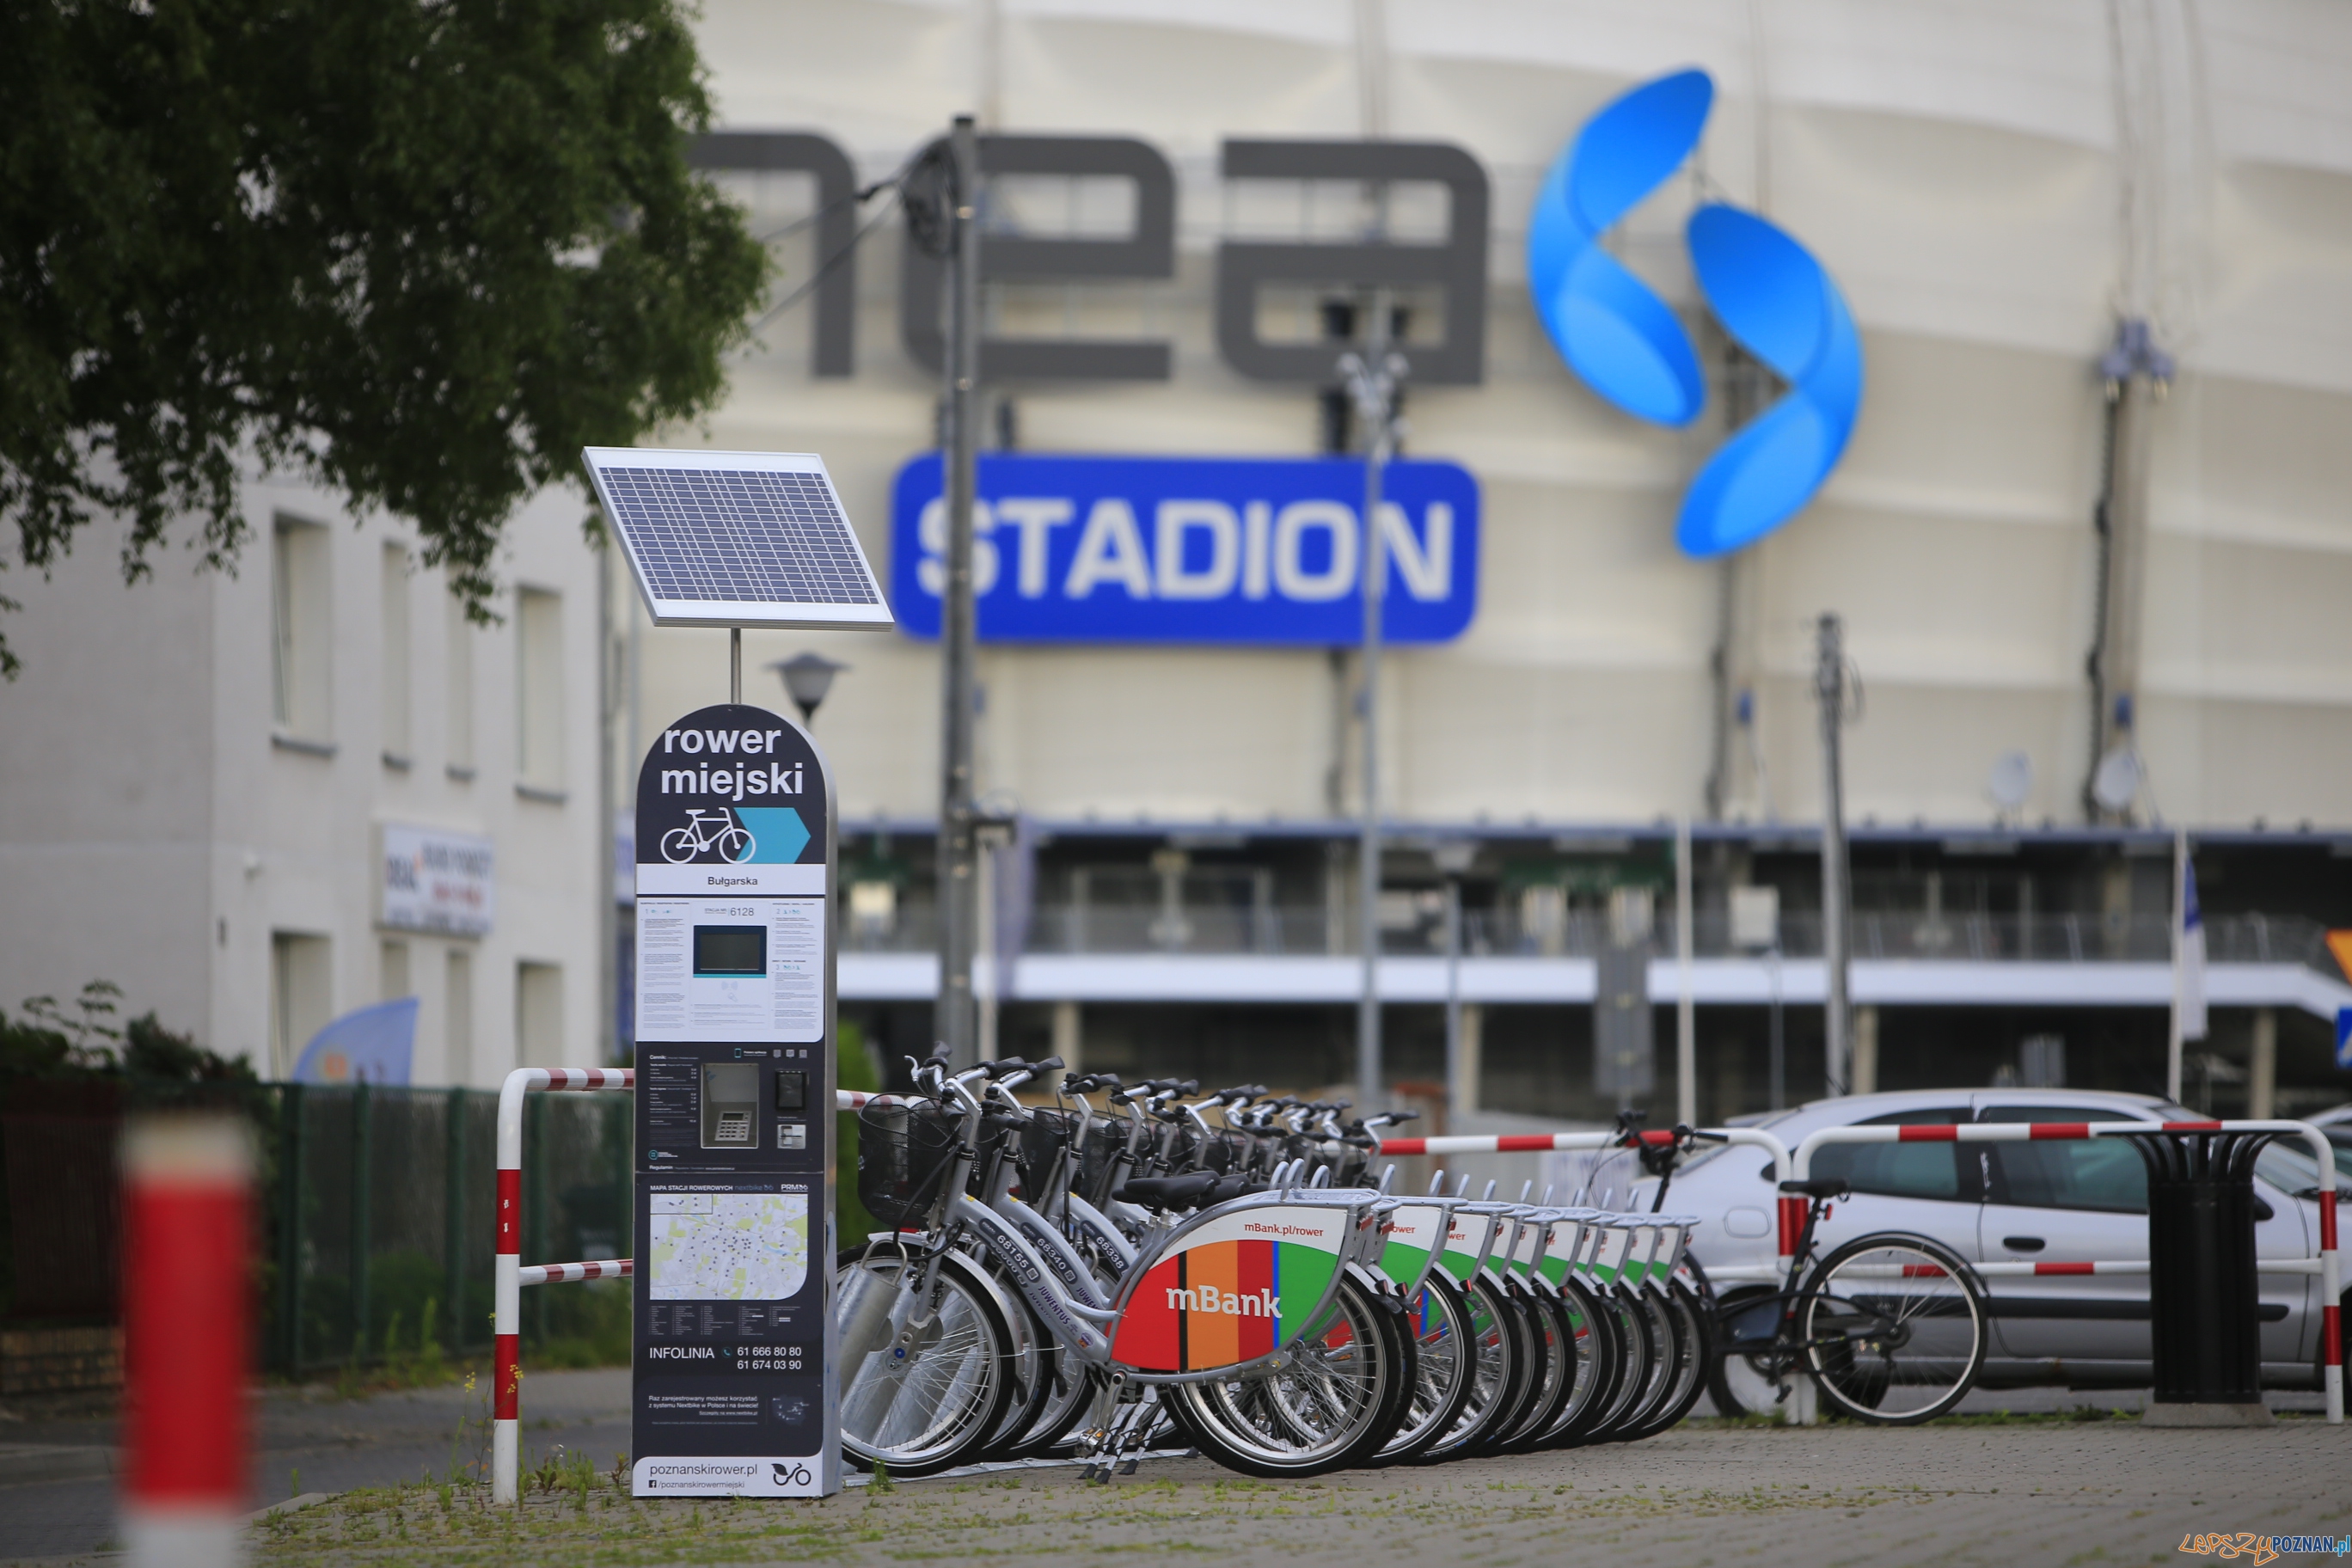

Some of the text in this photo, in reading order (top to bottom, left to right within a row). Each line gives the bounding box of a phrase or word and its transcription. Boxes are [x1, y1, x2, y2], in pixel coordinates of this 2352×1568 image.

[915, 495, 1454, 603] STADION
[665, 729, 781, 754] rower
[661, 762, 803, 802] miejski
[707, 876, 758, 887] Bułgarska
[730, 907, 755, 916] 6128
[1244, 1222, 1324, 1237] mBank.pl/rower
[997, 1234, 1029, 1269] 68155
[1037, 1238, 1066, 1270] 68340
[1096, 1236, 1124, 1269] 68338
[1038, 1285, 1071, 1325] JUWENTUS
[1166, 1284, 1283, 1319] mBank
[649, 1346, 802, 1359] INFOLINIA 61 666 80 80
[737, 1360, 802, 1369] 61 674 03 90
[650, 1463, 757, 1477] poznanskirower.pl
